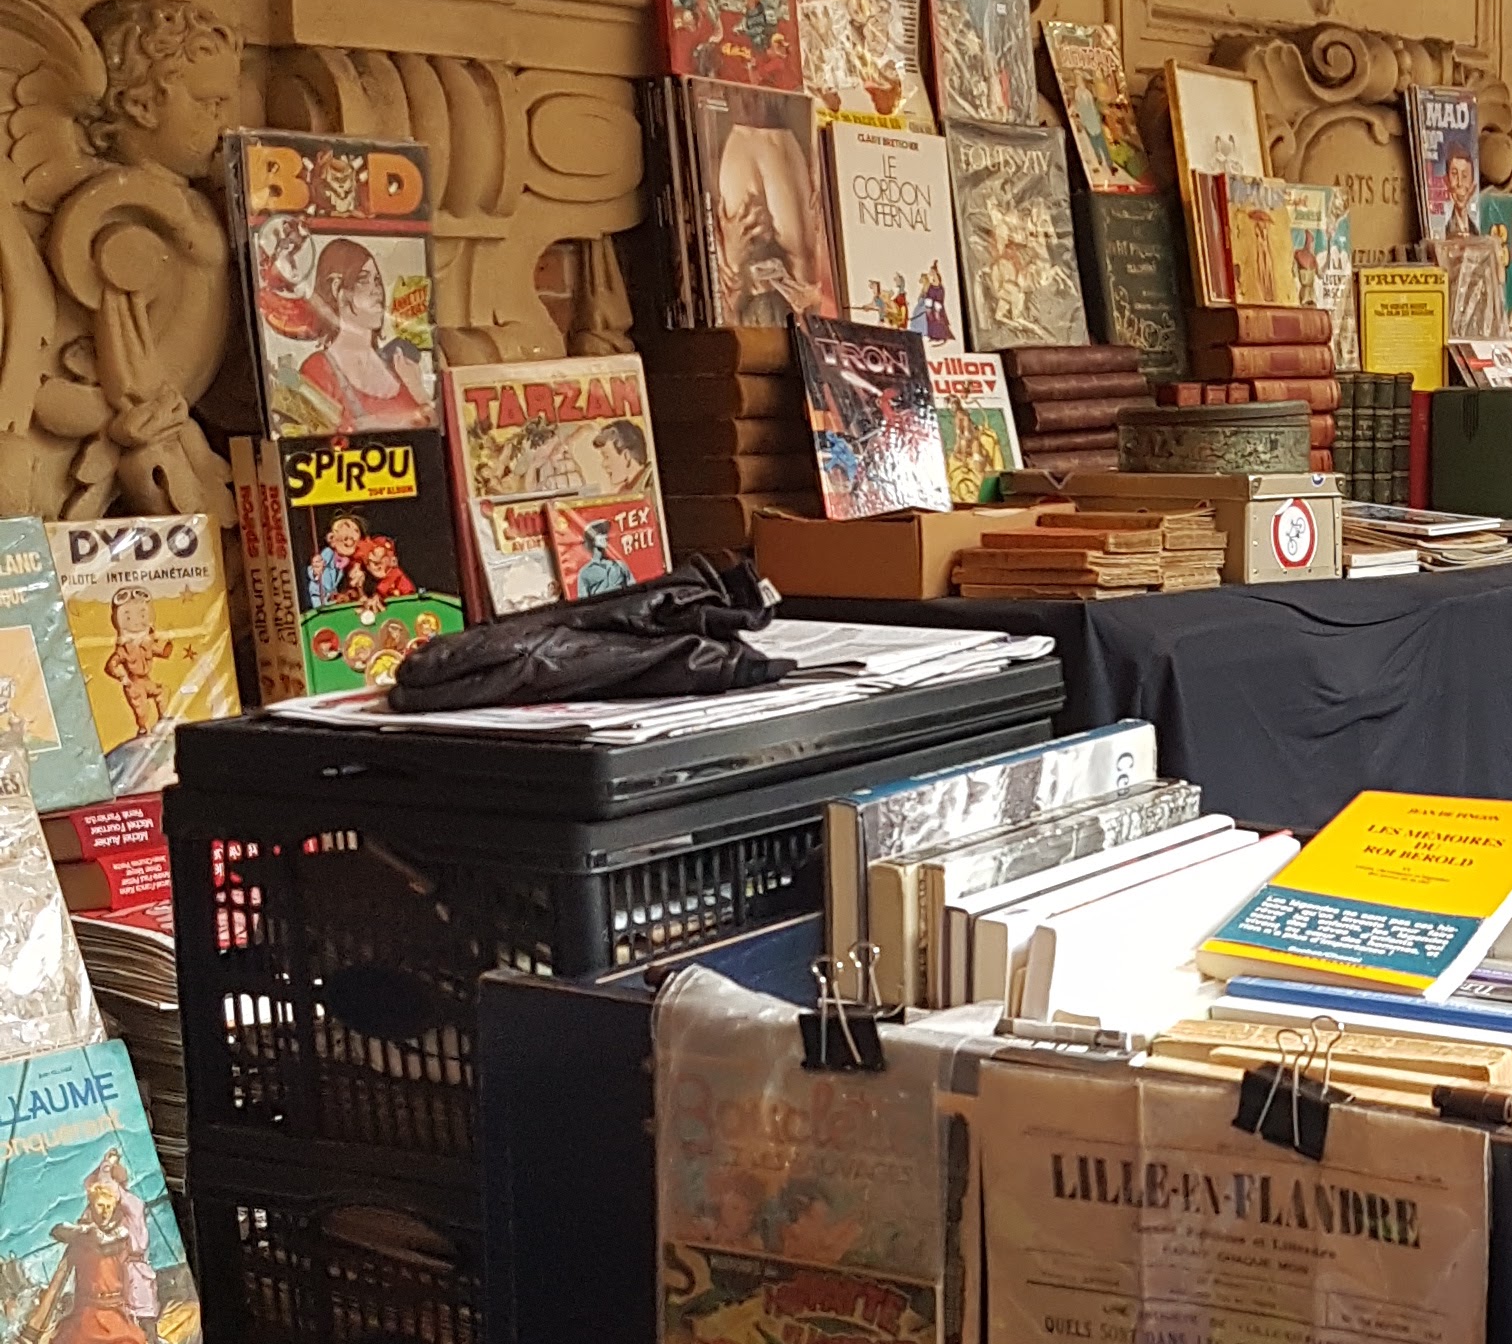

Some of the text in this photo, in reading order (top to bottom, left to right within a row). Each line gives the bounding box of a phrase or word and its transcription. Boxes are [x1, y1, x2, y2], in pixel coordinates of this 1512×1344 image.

[1425, 102, 1470, 131] MAD
[882, 154, 897, 180] LE
[853, 175, 931, 207] CORDON
[1333, 168, 1404, 205] ARTS CÉ
[859, 201, 931, 232] INFERNAL
[1364, 273, 1445, 286] PRIVATE
[814, 337, 910, 377] TRON
[927, 358, 996, 376] villon
[933, 380, 984, 394] uge
[464, 373, 641, 429] TARZAN
[286, 442, 410, 499] SPIROU
[615, 506, 650, 532] TEX
[68, 524, 199, 564] DYDO
[60, 565, 210, 586] PILOTE INTERPLANÉTAIRE
[122, 831, 149, 844] Michel
[126, 818, 154, 832] Michel
[1367, 824, 1402, 835] LES
[1414, 842, 1441, 851] DU
[1044, 1316, 1092, 1340] QUELS
